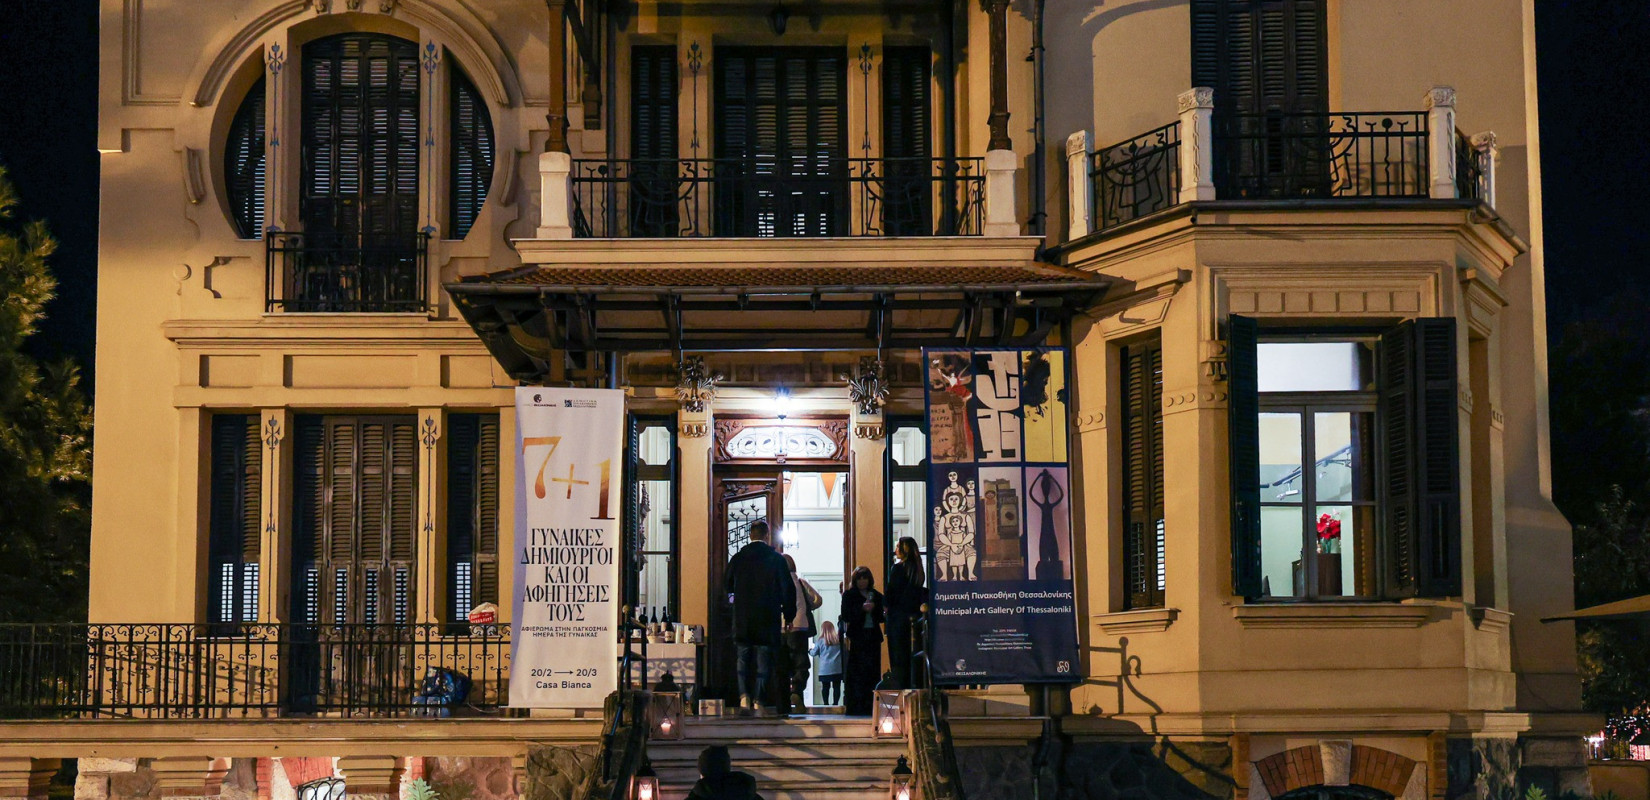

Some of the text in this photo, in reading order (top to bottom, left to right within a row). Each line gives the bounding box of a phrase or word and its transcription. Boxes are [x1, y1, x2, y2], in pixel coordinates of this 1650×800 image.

[531, 528, 604, 546] ΓΥΝΑΙΚΕΣ
[520, 546, 613, 565] ΔΗΜΙΟΥΡΓΟΙ
[544, 565, 589, 584] ΚΑΙ ΟΙ
[522, 585, 609, 602] ΑΦΗΓΗΣΕΙΣ
[934, 590, 1072, 601] Δημοτική Πινακοθήκη Θεσσαλονίκης
[546, 603, 585, 621] ΤΟΥΣ
[935, 605, 1072, 617] Municipal Art Gallery Of Thessaloniki
[531, 668, 597, 677] 20/2 20/3
[536, 681, 592, 689] Casa Bianca
